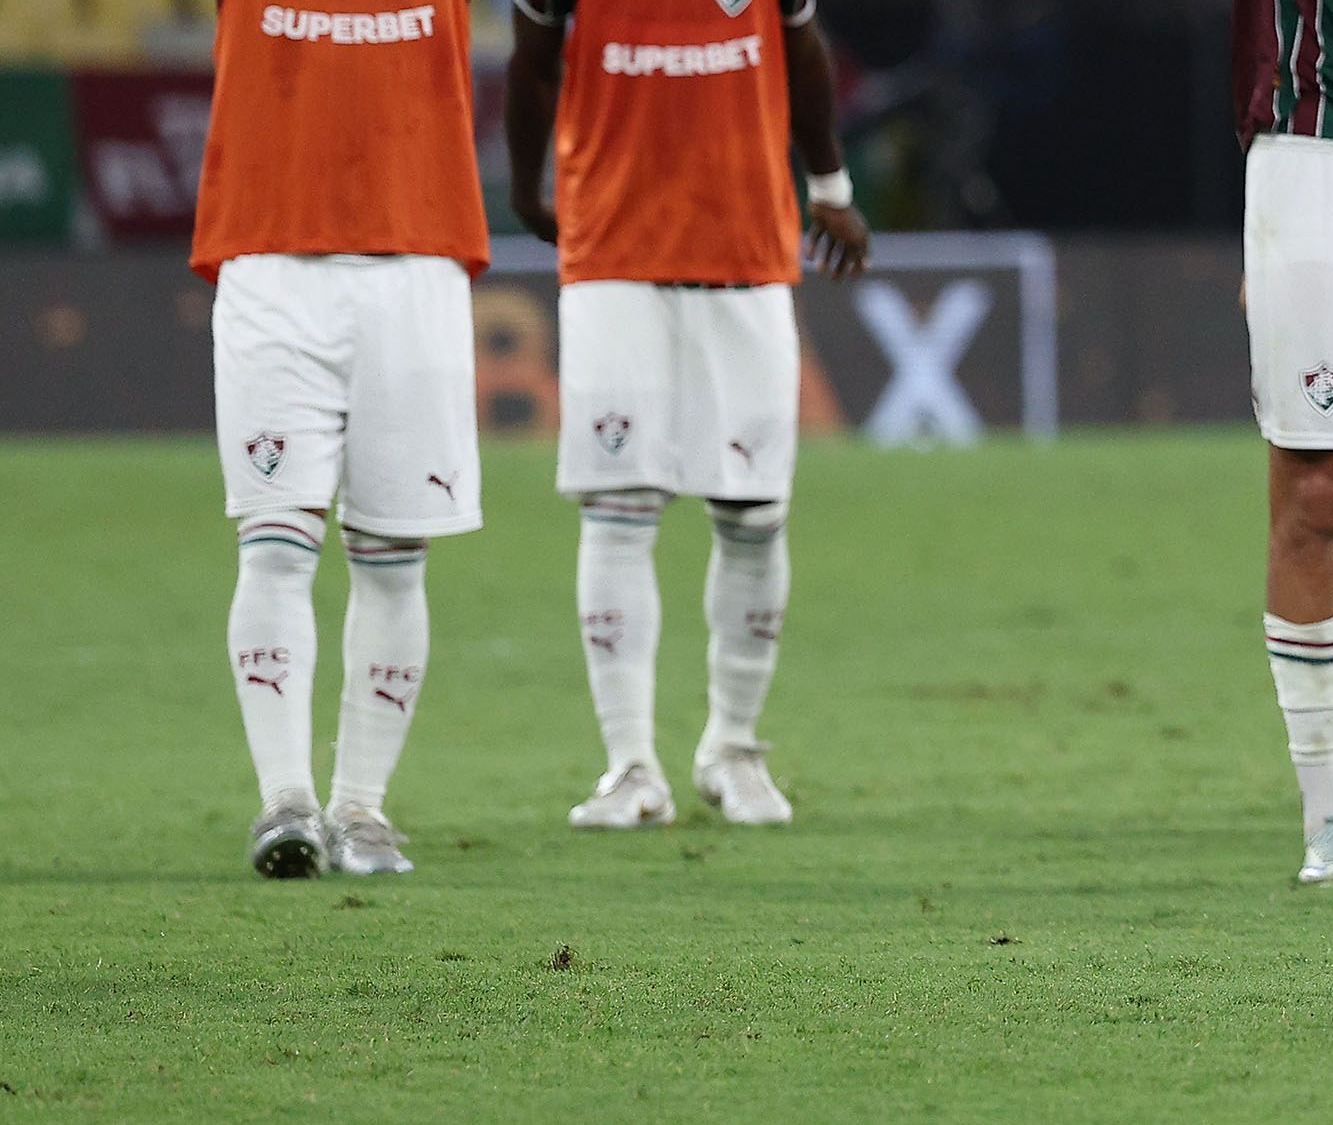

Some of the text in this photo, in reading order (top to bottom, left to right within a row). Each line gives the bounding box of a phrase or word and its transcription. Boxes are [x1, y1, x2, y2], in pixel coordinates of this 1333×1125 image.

[261, 4, 436, 44] SUPERBET
[602, 34, 763, 77] SUPERBET
[238, 646, 290, 667] FFC
[369, 663, 420, 683] FFC
